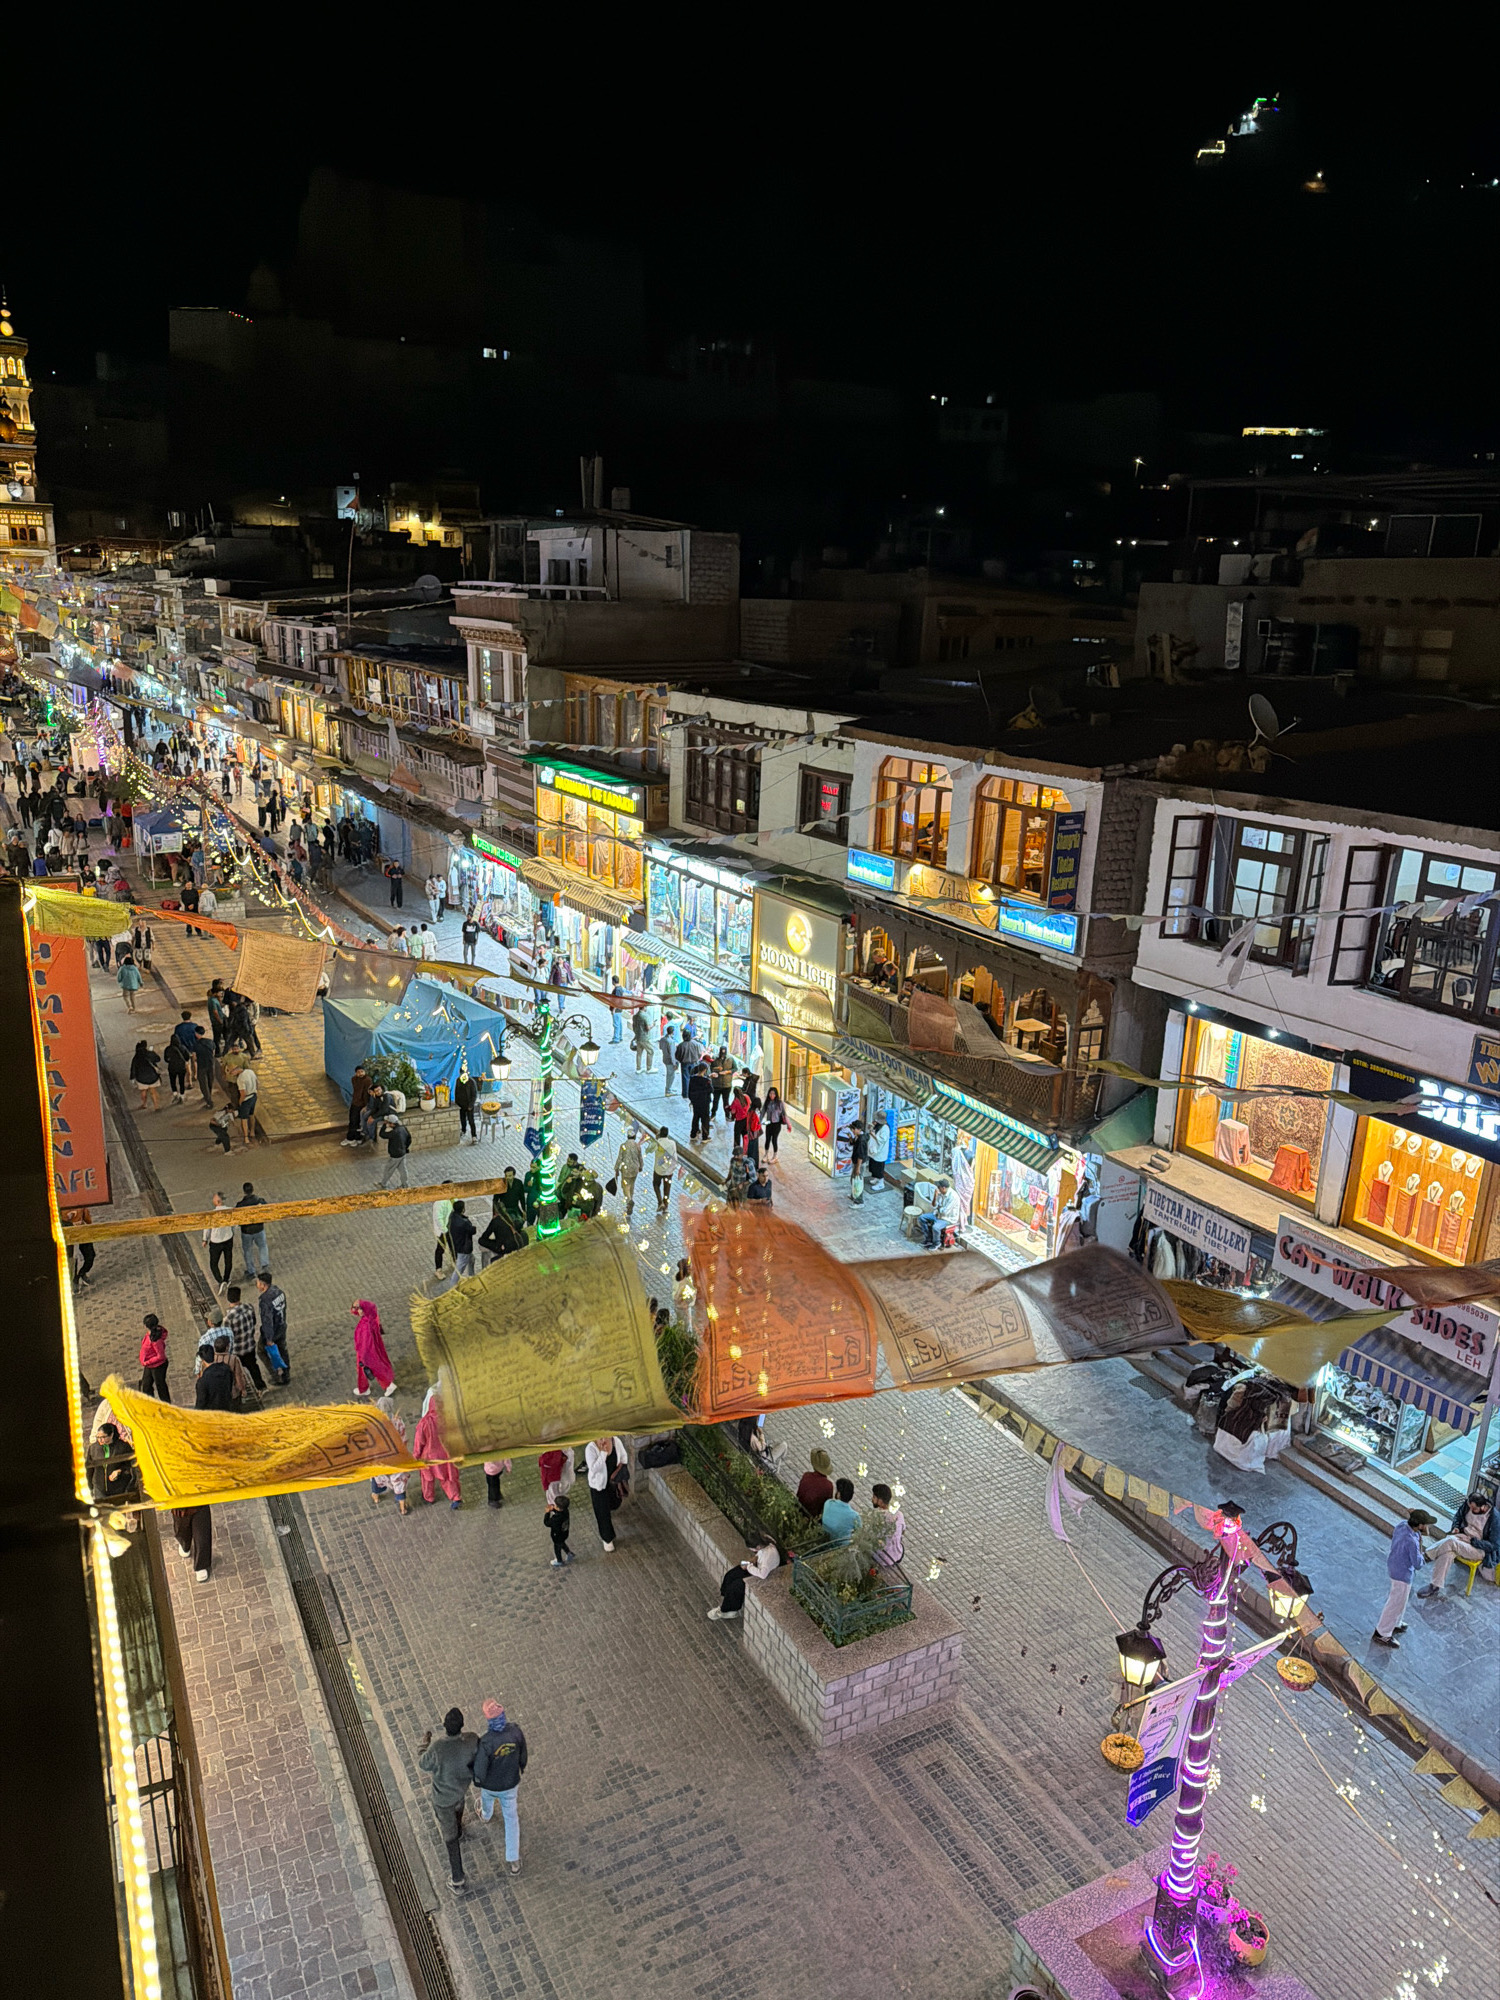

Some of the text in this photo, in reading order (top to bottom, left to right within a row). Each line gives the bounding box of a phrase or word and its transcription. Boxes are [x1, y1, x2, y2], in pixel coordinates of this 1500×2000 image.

[760, 942, 798, 974] MOON
[799, 960, 837, 991] LIGHT
[880, 1052, 903, 1077] FOOT
[904, 1064, 931, 1091] WEAR
[966, 1095, 1050, 1147] HANDICRAFTS
[808, 1132, 834, 1171] LEH
[54, 1167, 98, 1195] AFE
[1148, 1188, 1184, 1220] TIBETAN
[1185, 1208, 1204, 1231] ART
[1204, 1219, 1249, 1254] GALLERY
[1154, 1208, 1199, 1238] TANTRIQUE
[1203, 1235, 1229, 1254] TIBET
[1279, 1234, 1326, 1274] CAT
[1332, 1258, 1404, 1310] WALK
[1410, 1308, 1486, 1356] SHOES
[1456, 1351, 1481, 1370] LEH
